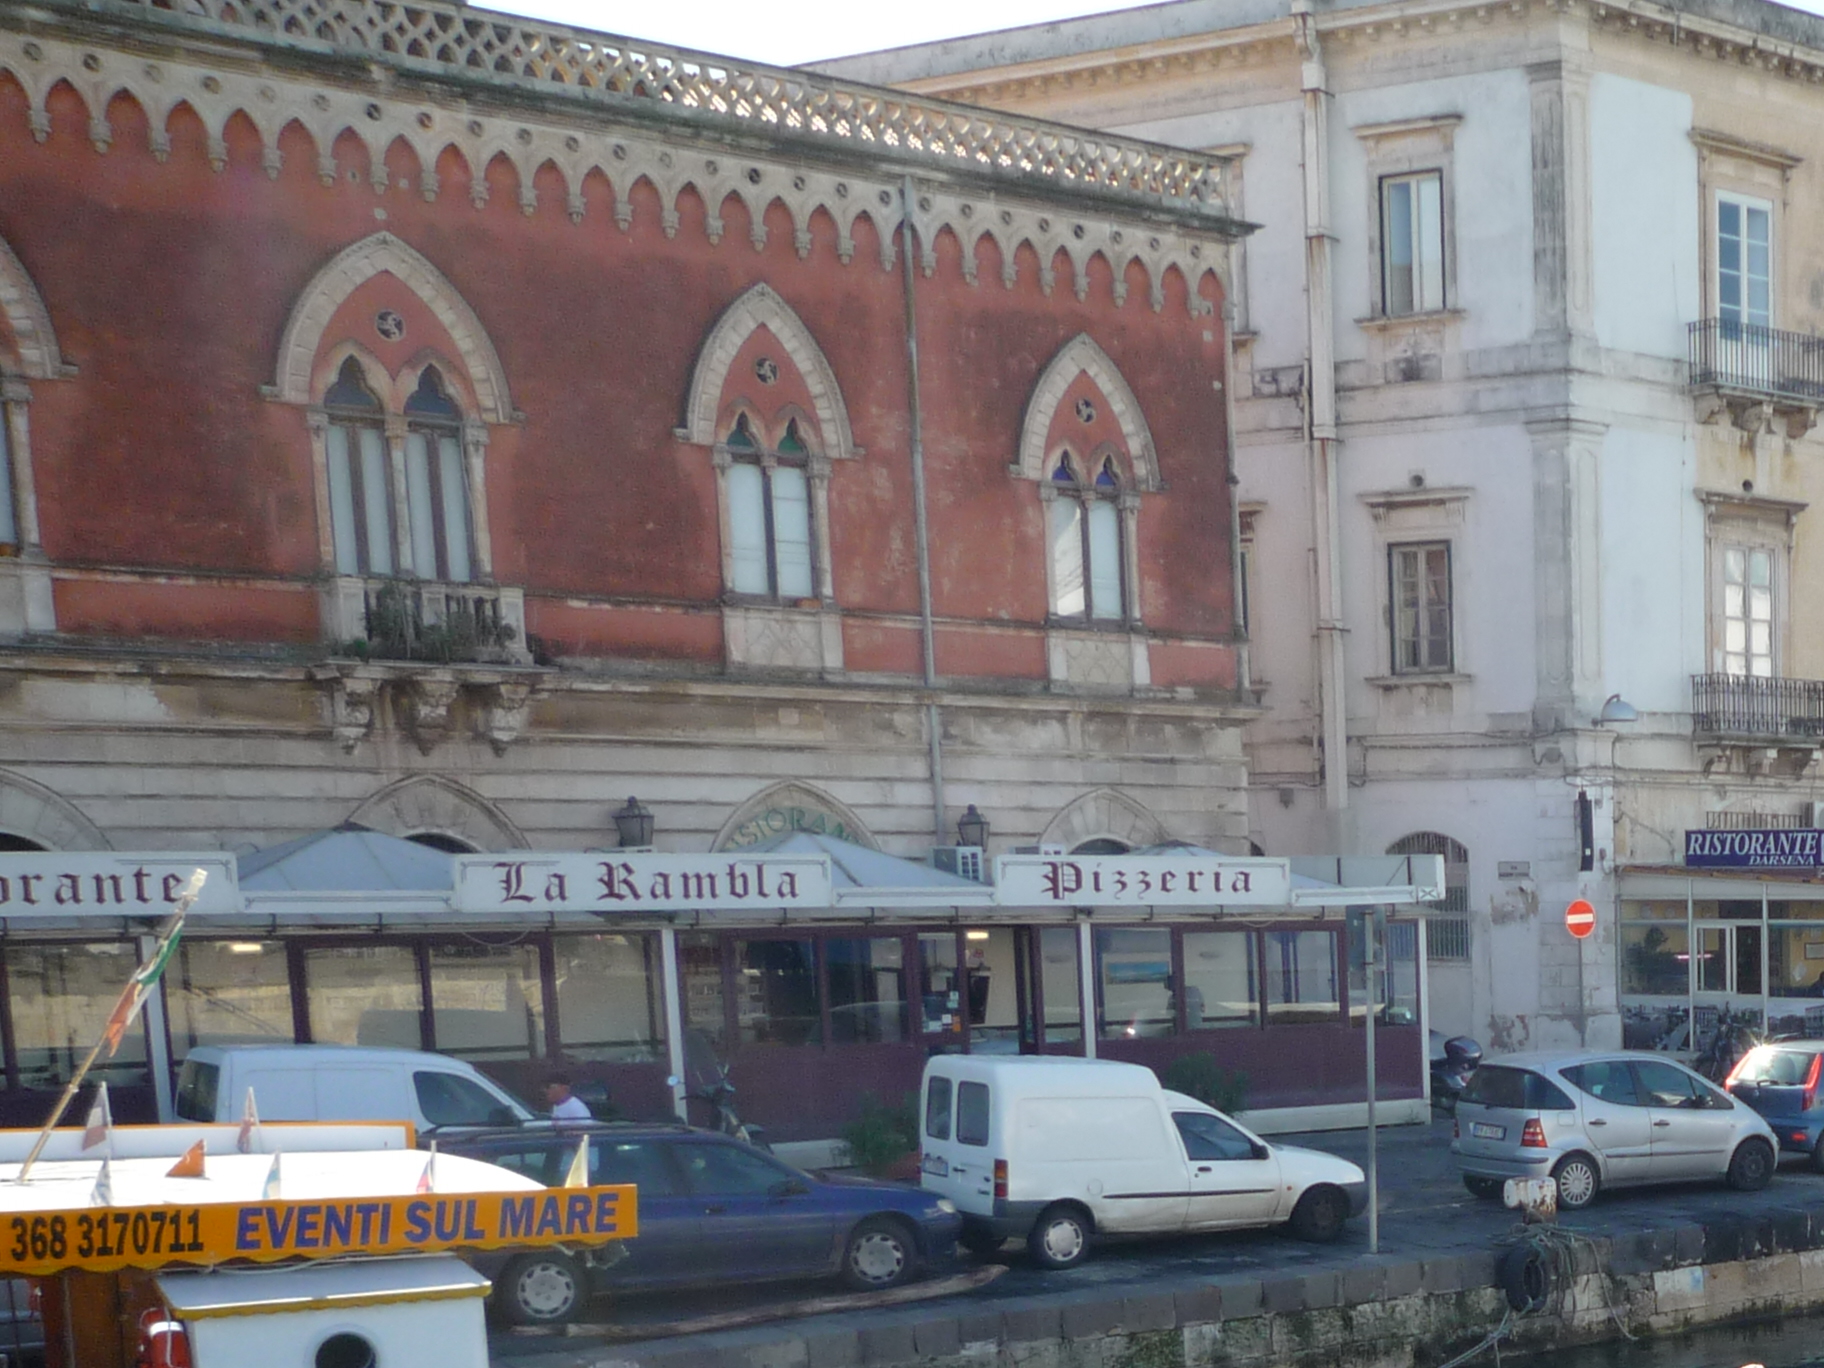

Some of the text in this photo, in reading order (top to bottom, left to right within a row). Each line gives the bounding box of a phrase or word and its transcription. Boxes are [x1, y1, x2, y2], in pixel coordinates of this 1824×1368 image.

[1688, 832, 1819, 856] RISTORANTE
[1749, 854, 1815, 866] DARSENA
[493, 861, 800, 903] La Rambla
[1041, 861, 1252, 900] Pizzeria
[11, 1193, 619, 1261] 368 3170711 EVENTI SUL MARE
